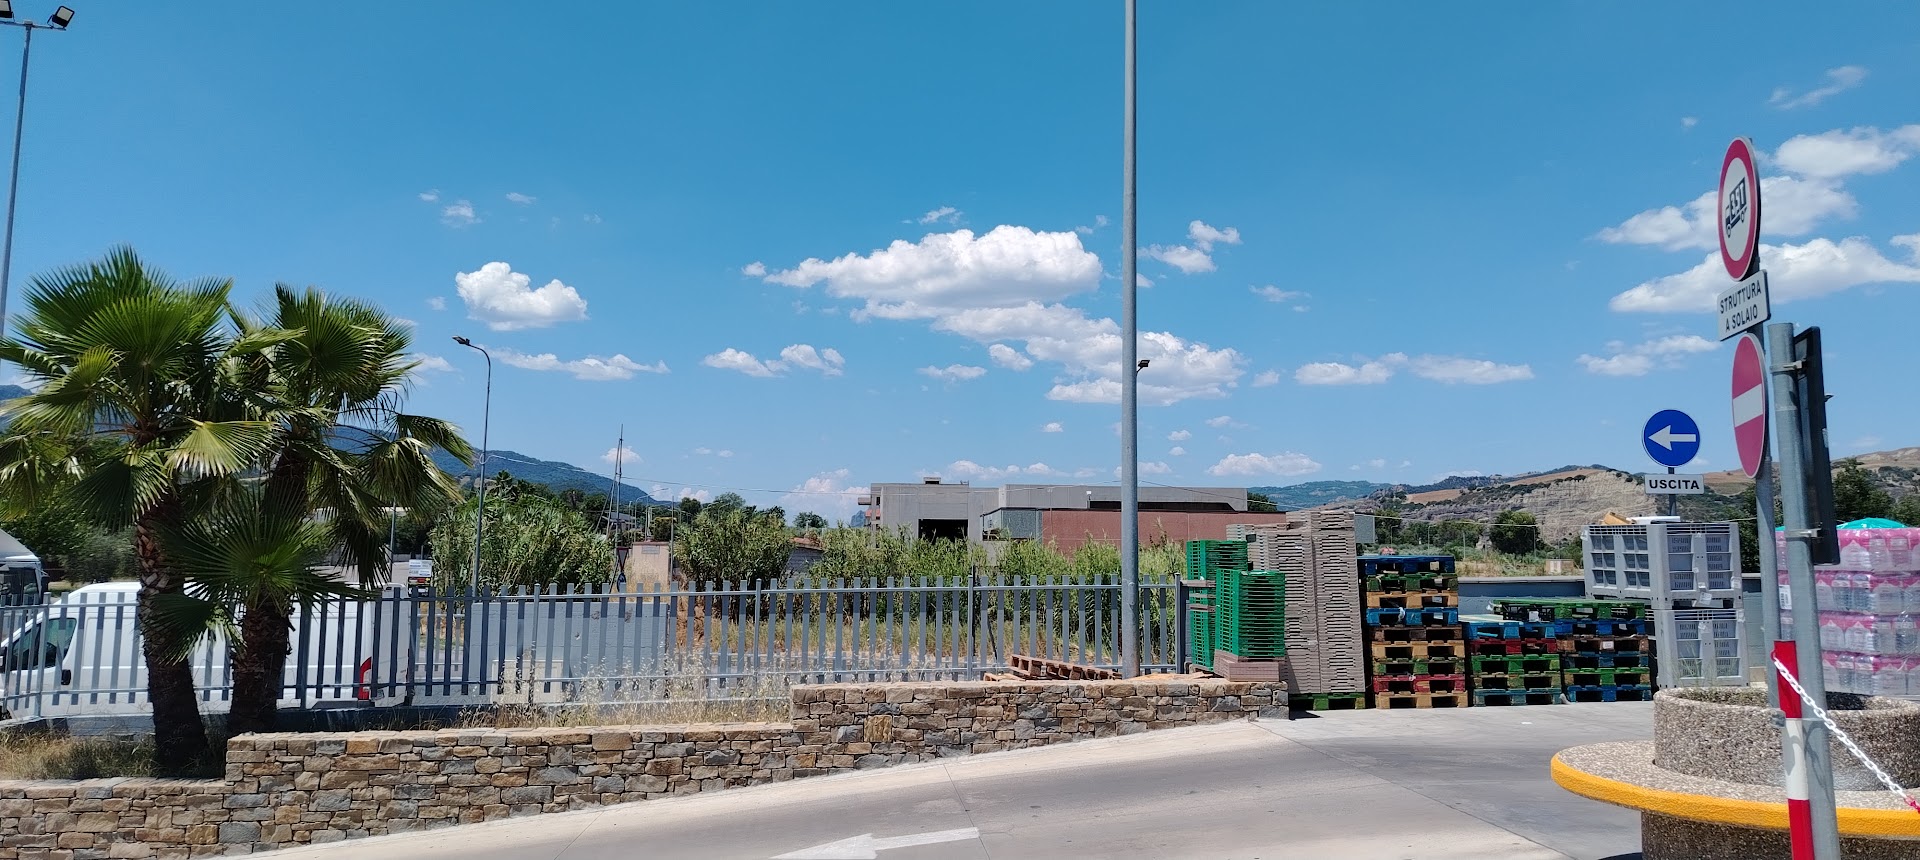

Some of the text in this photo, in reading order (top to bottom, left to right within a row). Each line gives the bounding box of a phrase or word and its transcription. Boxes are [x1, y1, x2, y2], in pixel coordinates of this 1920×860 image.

[1720, 280, 1761, 314] STRUTTURA
[1726, 304, 1758, 332] A SOLAIO
[1649, 479, 1699, 489] USCITA
